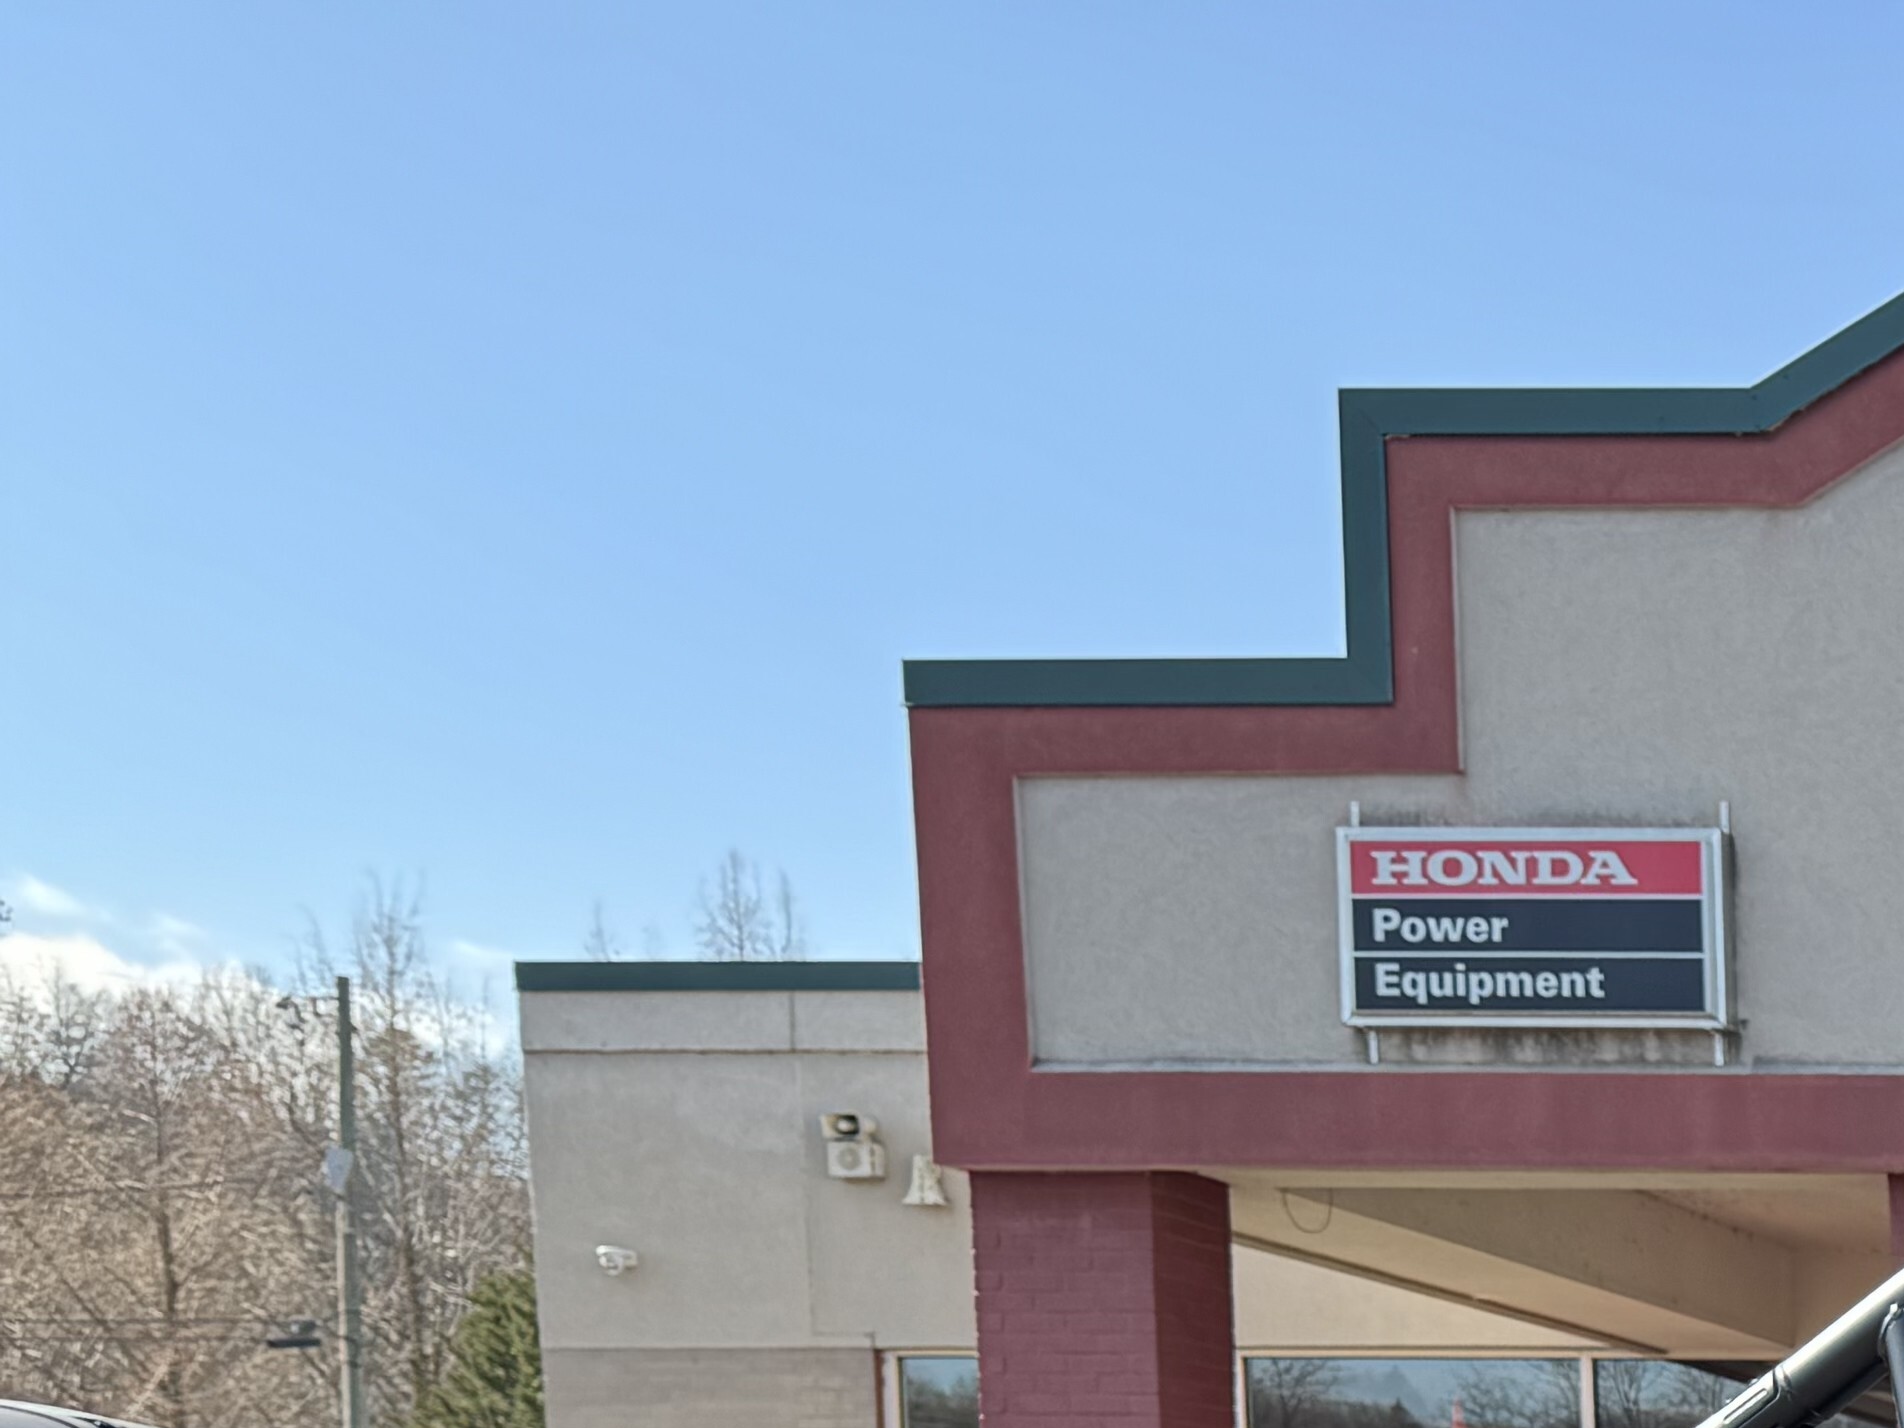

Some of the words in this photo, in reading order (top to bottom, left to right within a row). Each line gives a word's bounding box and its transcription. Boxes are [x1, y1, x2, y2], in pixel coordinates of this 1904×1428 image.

[1370, 850, 1639, 886] HONDA
[1371, 907, 1509, 943] Power
[1374, 961, 1606, 1005] Equipment
